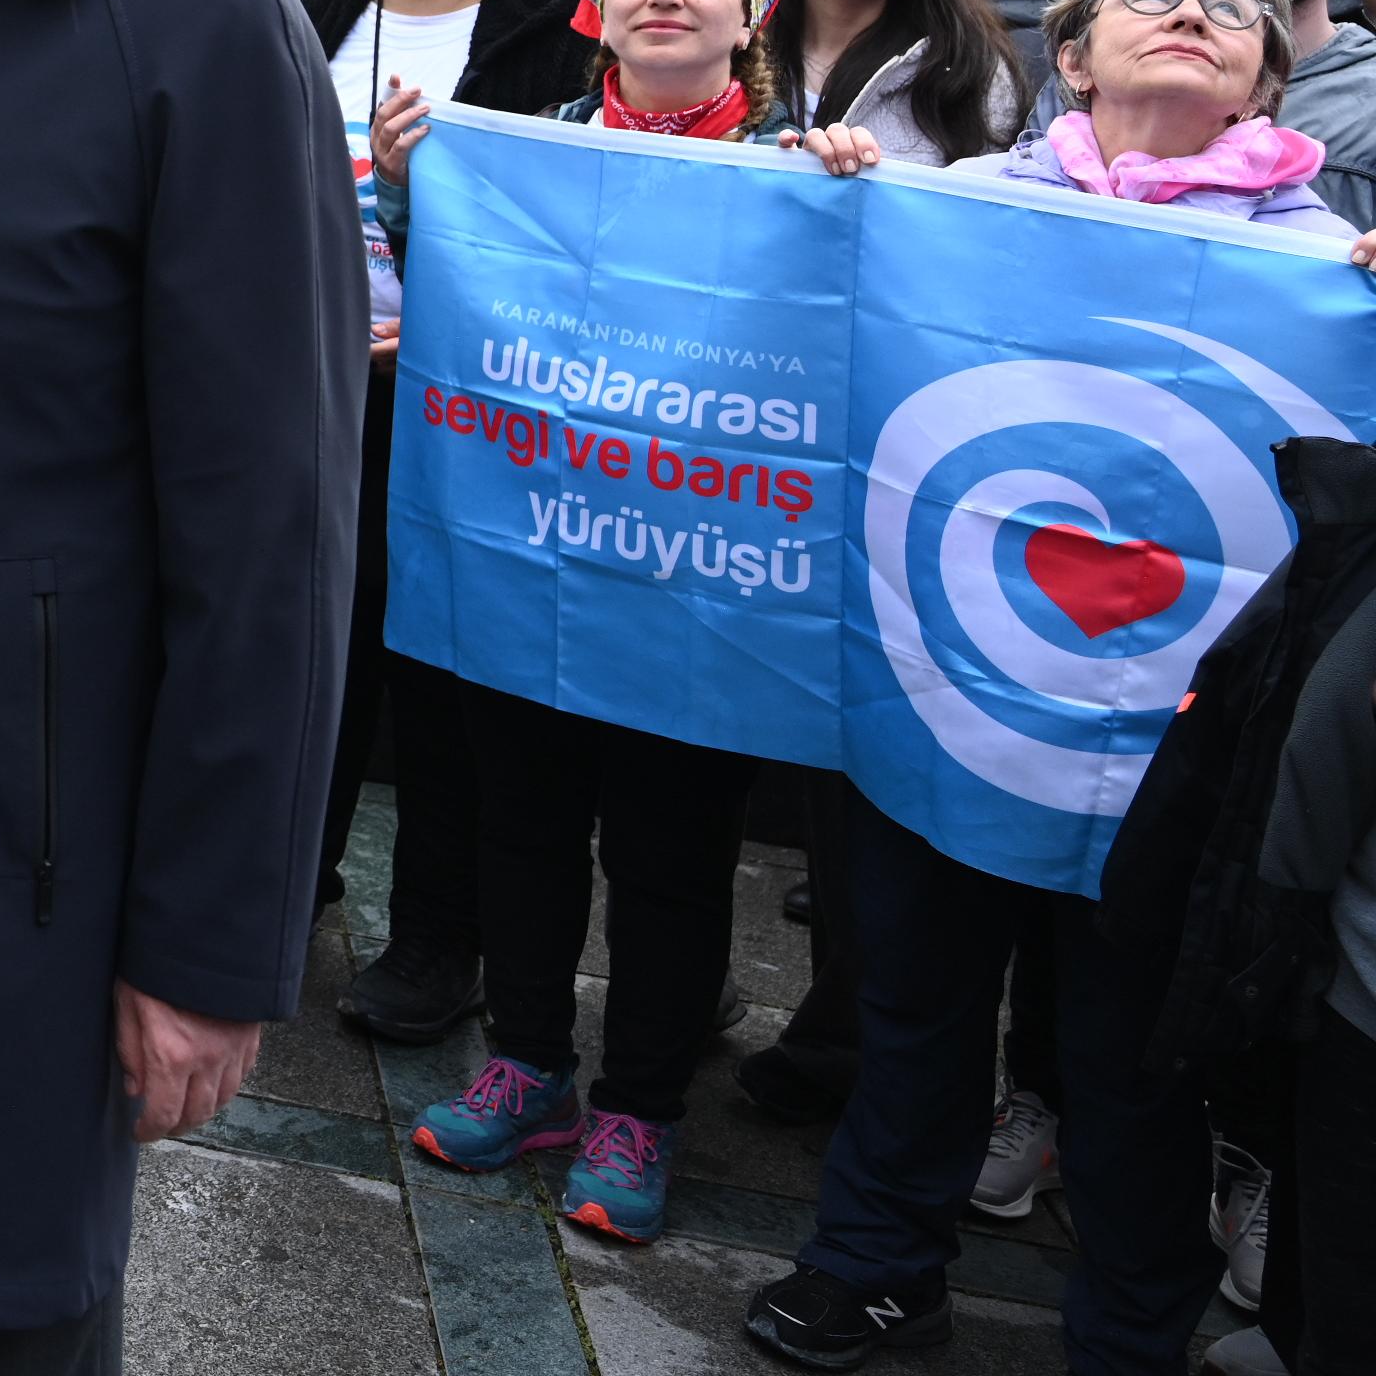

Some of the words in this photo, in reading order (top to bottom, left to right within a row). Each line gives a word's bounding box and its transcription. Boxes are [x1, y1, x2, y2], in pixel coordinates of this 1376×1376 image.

[481, 336, 817, 444] uluslararası
[491, 299, 667, 353] KARAMAN'DAN
[674, 338, 806, 375] KONYA'YA
[423, 386, 549, 467] sevgi
[561, 426, 632, 480] ve
[647, 436, 814, 523] barış
[527, 490, 811, 597] yürüyüşü
